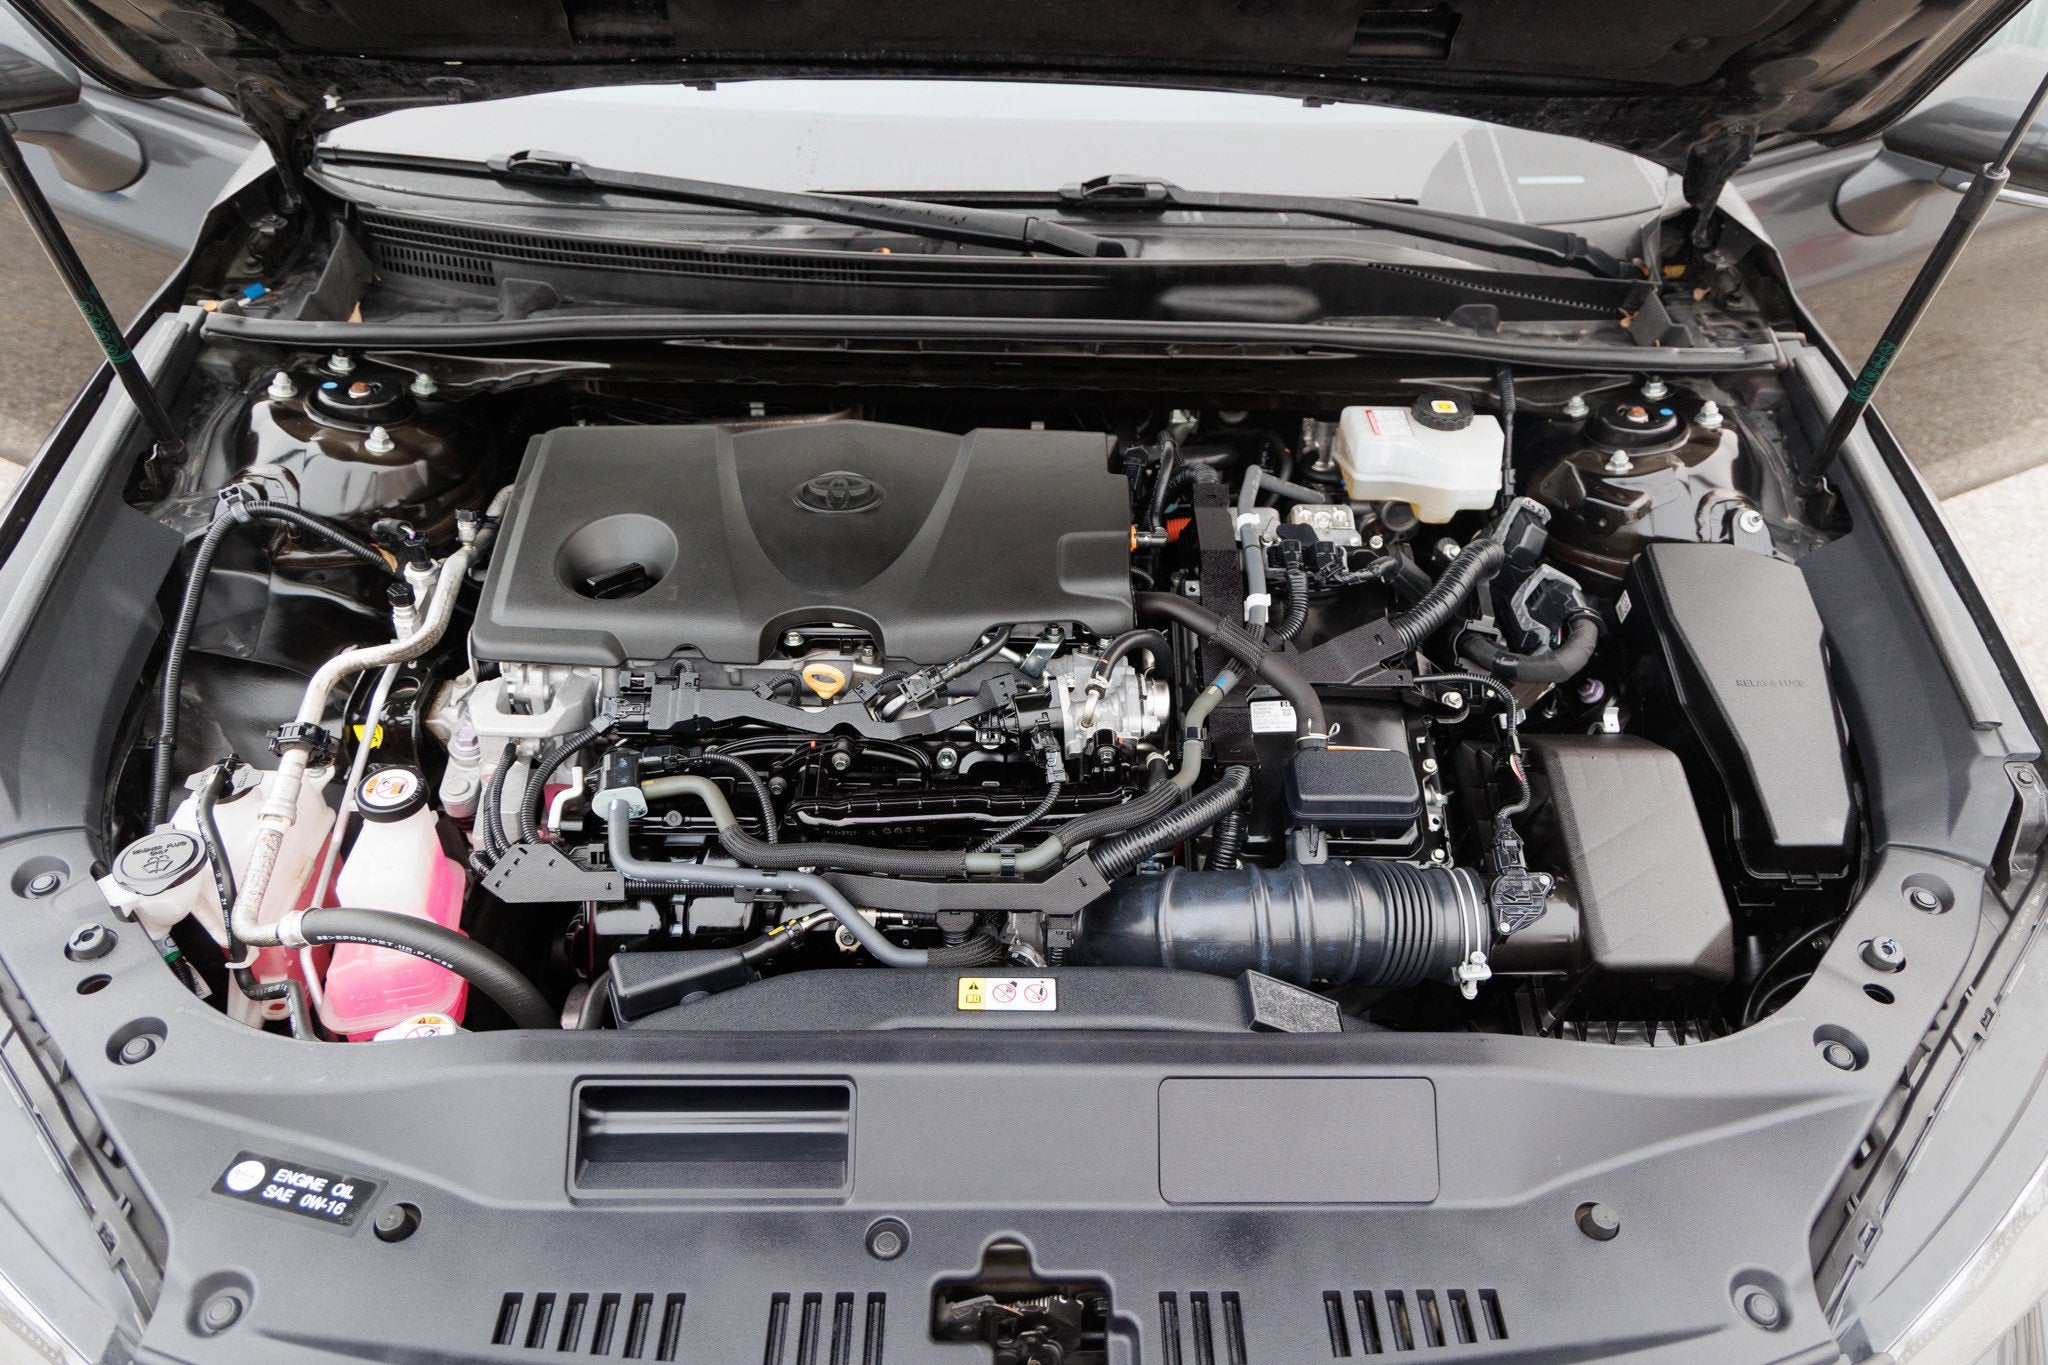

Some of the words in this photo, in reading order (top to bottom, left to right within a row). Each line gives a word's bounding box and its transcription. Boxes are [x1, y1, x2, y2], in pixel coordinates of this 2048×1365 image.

[262, 1184, 296, 1203] SAE
[300, 1193, 347, 1216] 0W-16
[273, 1168, 329, 1193] ENGINE
[331, 1183, 354, 1200] OIL
